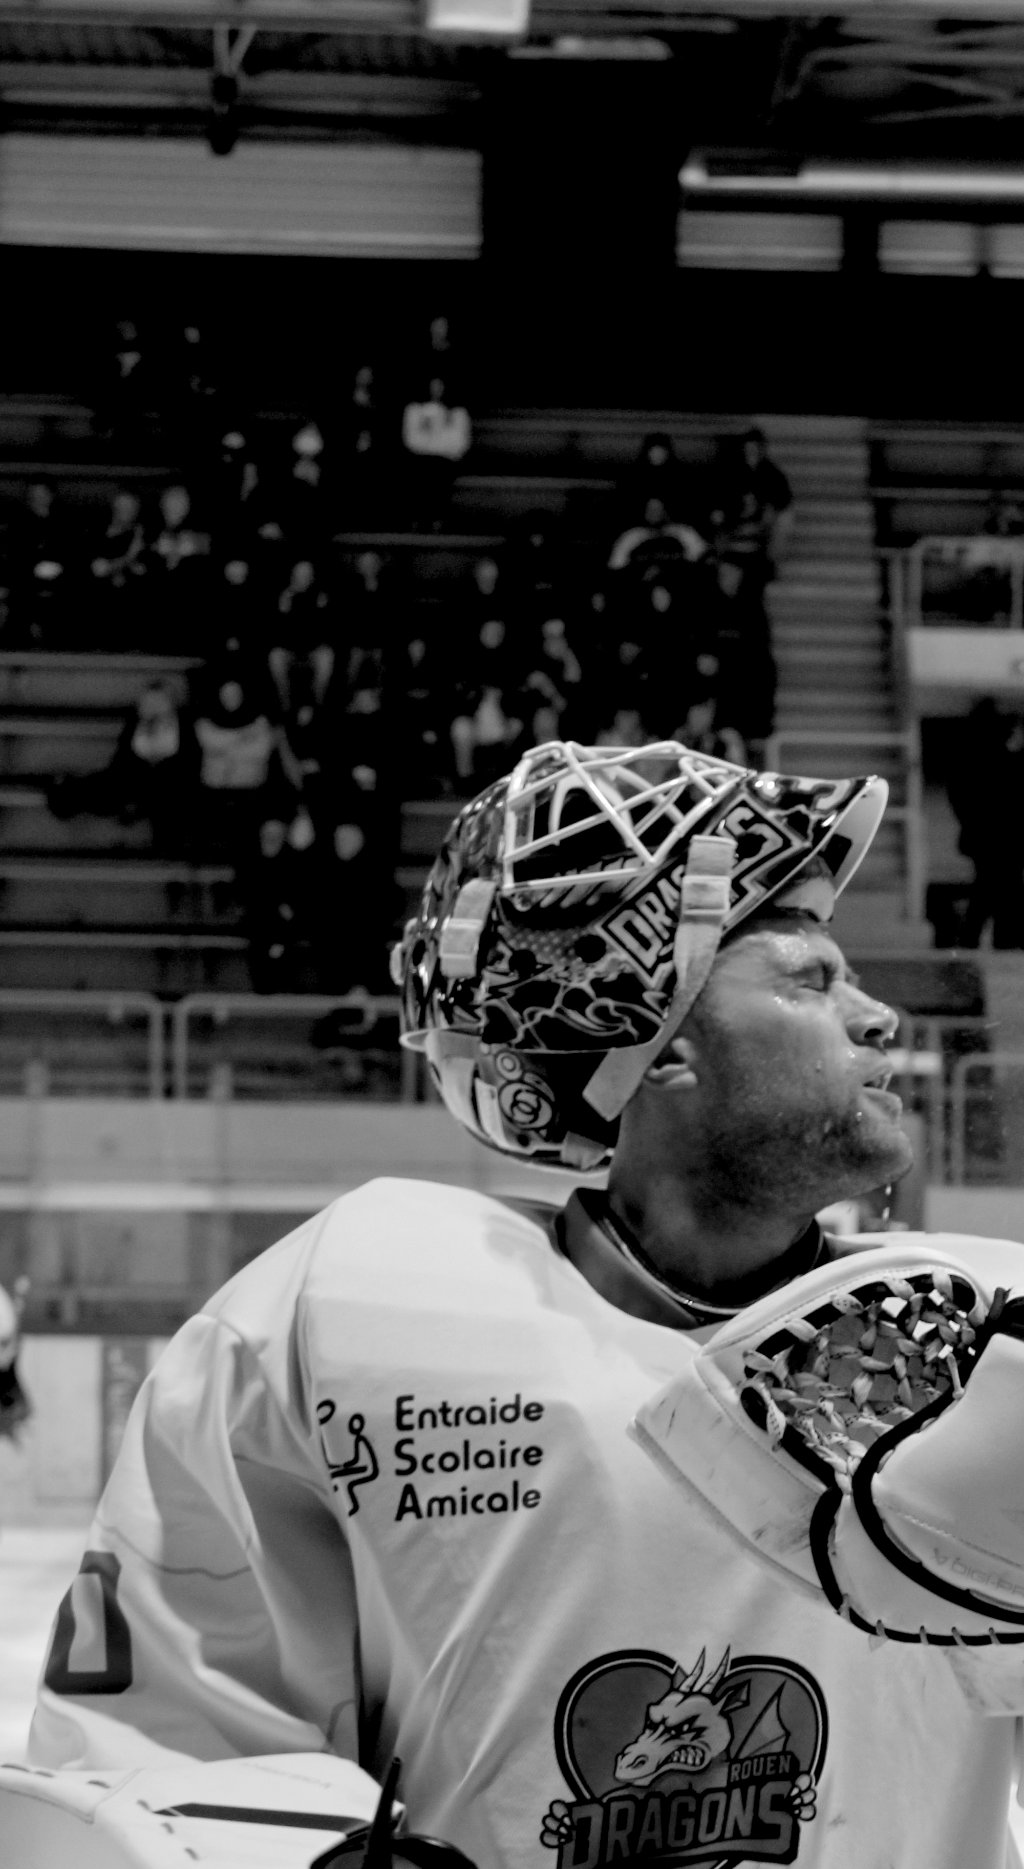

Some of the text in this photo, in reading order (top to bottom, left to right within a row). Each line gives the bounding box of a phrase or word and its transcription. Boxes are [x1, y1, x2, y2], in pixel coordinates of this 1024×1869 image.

[396, 1393, 545, 1431] Entraide
[395, 1438, 544, 1476] Scolaire
[394, 1480, 542, 1521] Amicale
[730, 1754, 792, 1783] ROUEN
[561, 1781, 794, 1869] DRAGONS
